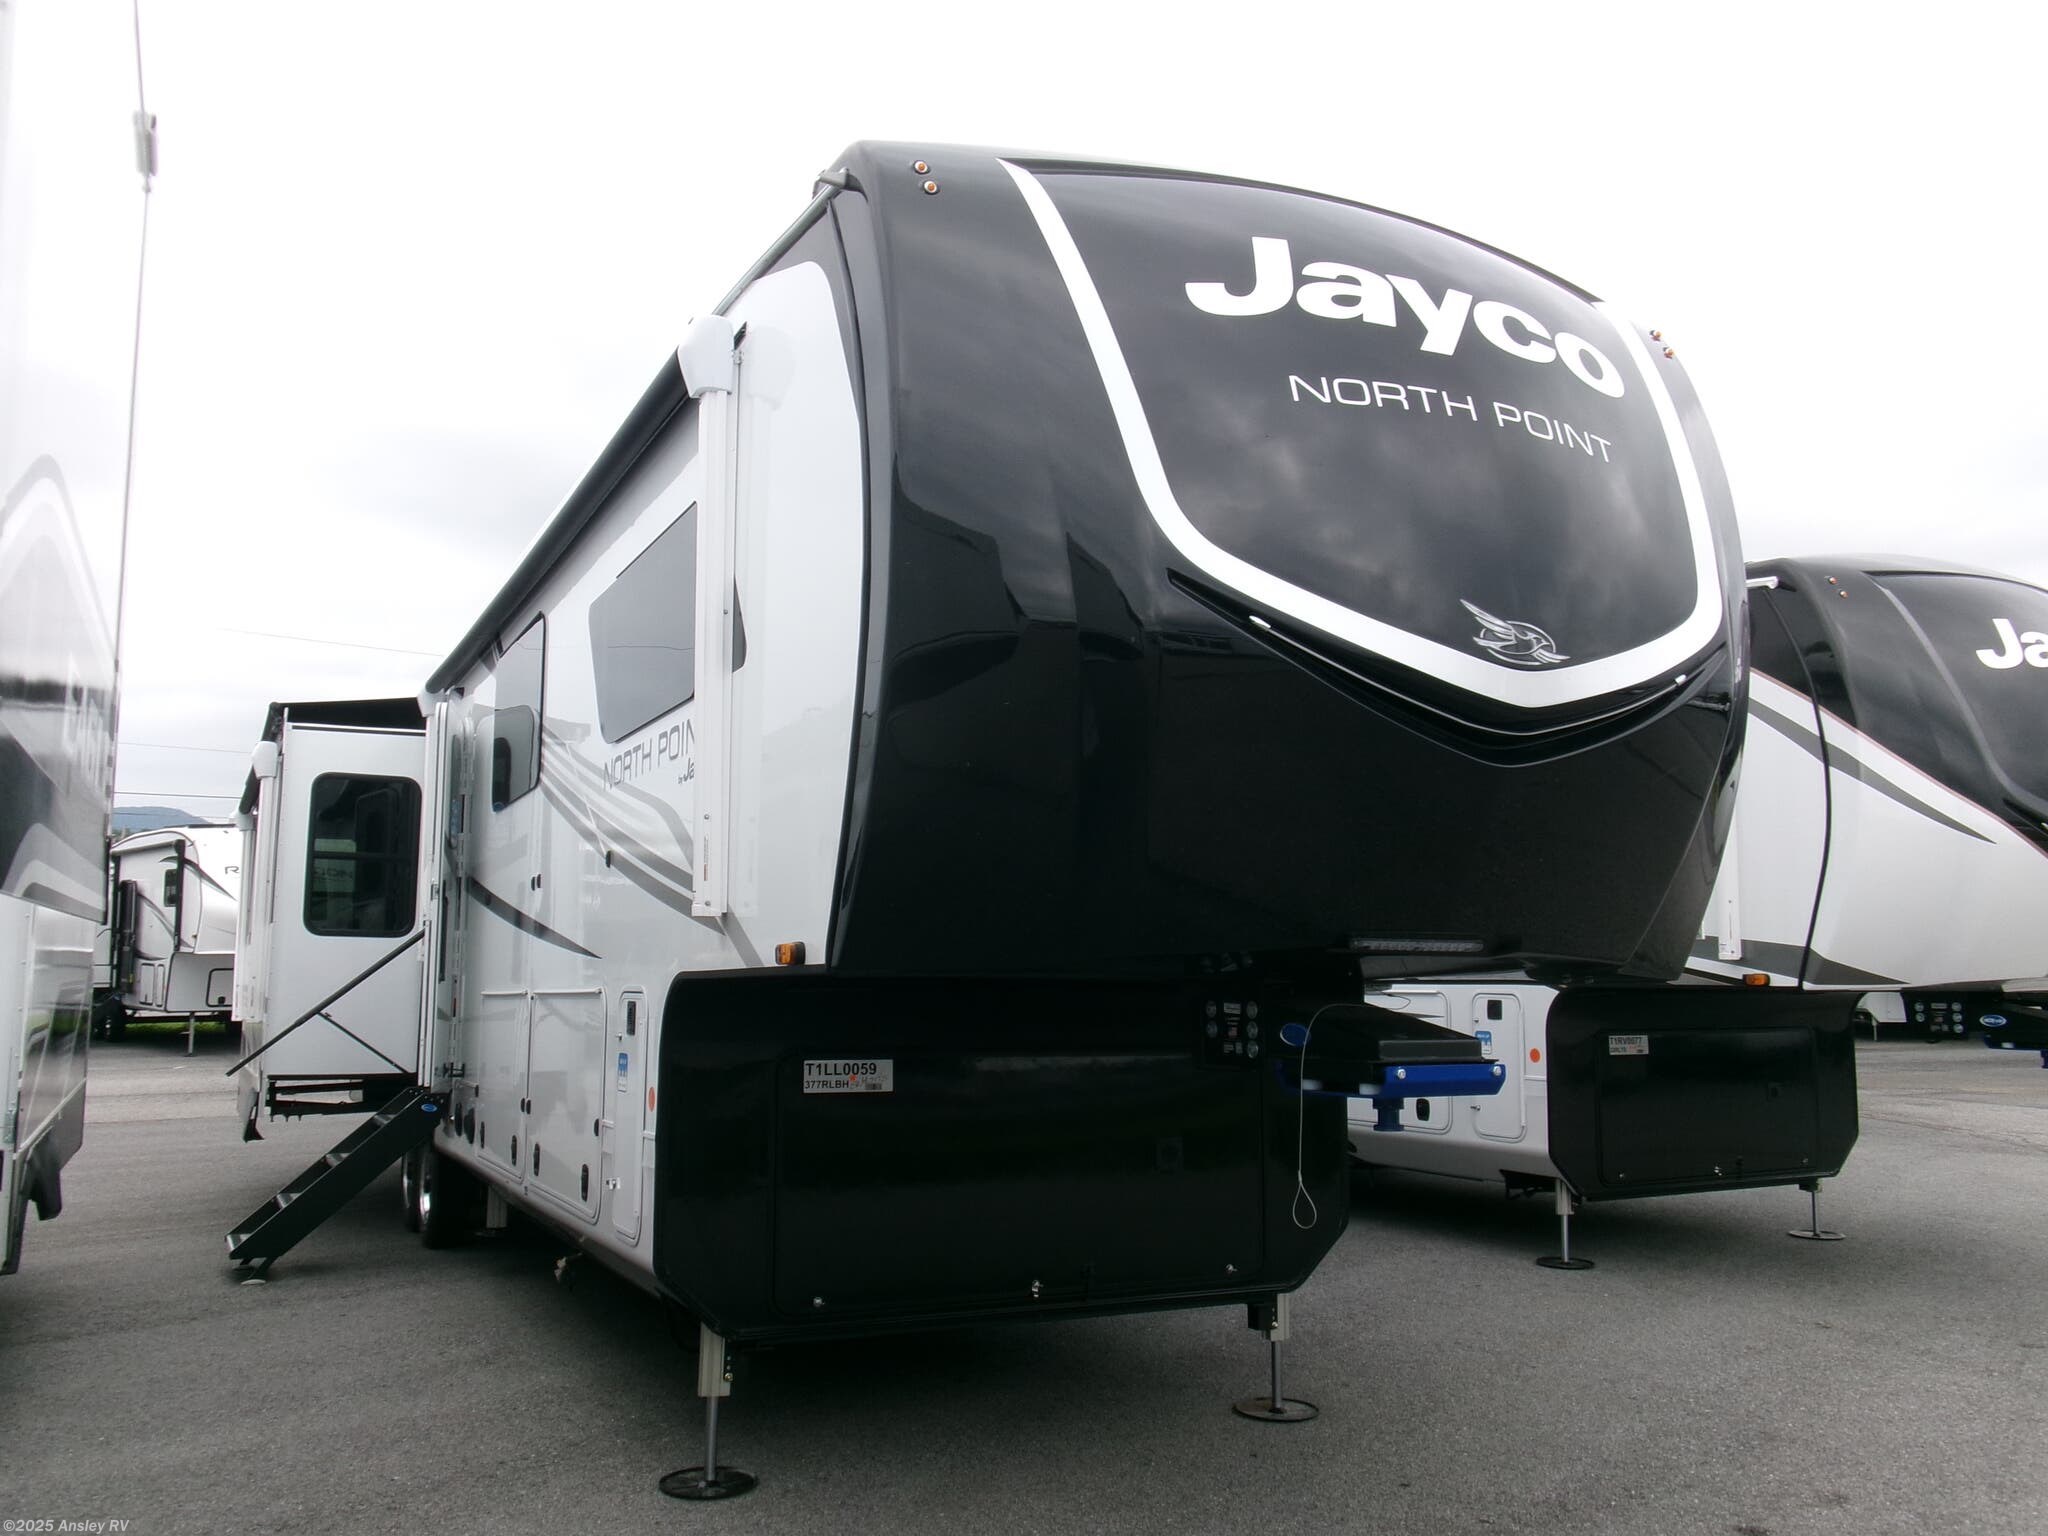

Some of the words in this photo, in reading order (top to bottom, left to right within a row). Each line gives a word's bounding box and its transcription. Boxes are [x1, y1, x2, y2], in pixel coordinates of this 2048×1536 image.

[1185, 236, 1625, 398] Jayco
[1289, 374, 1478, 421] NORTH
[1493, 402, 1612, 462] POINT
[1976, 618, 2048, 669] Ja
[603, 738, 652, 791] NORTH
[804, 1080, 849, 1089] 377RLBH
[805, 1062, 877, 1076] T1LL0059
